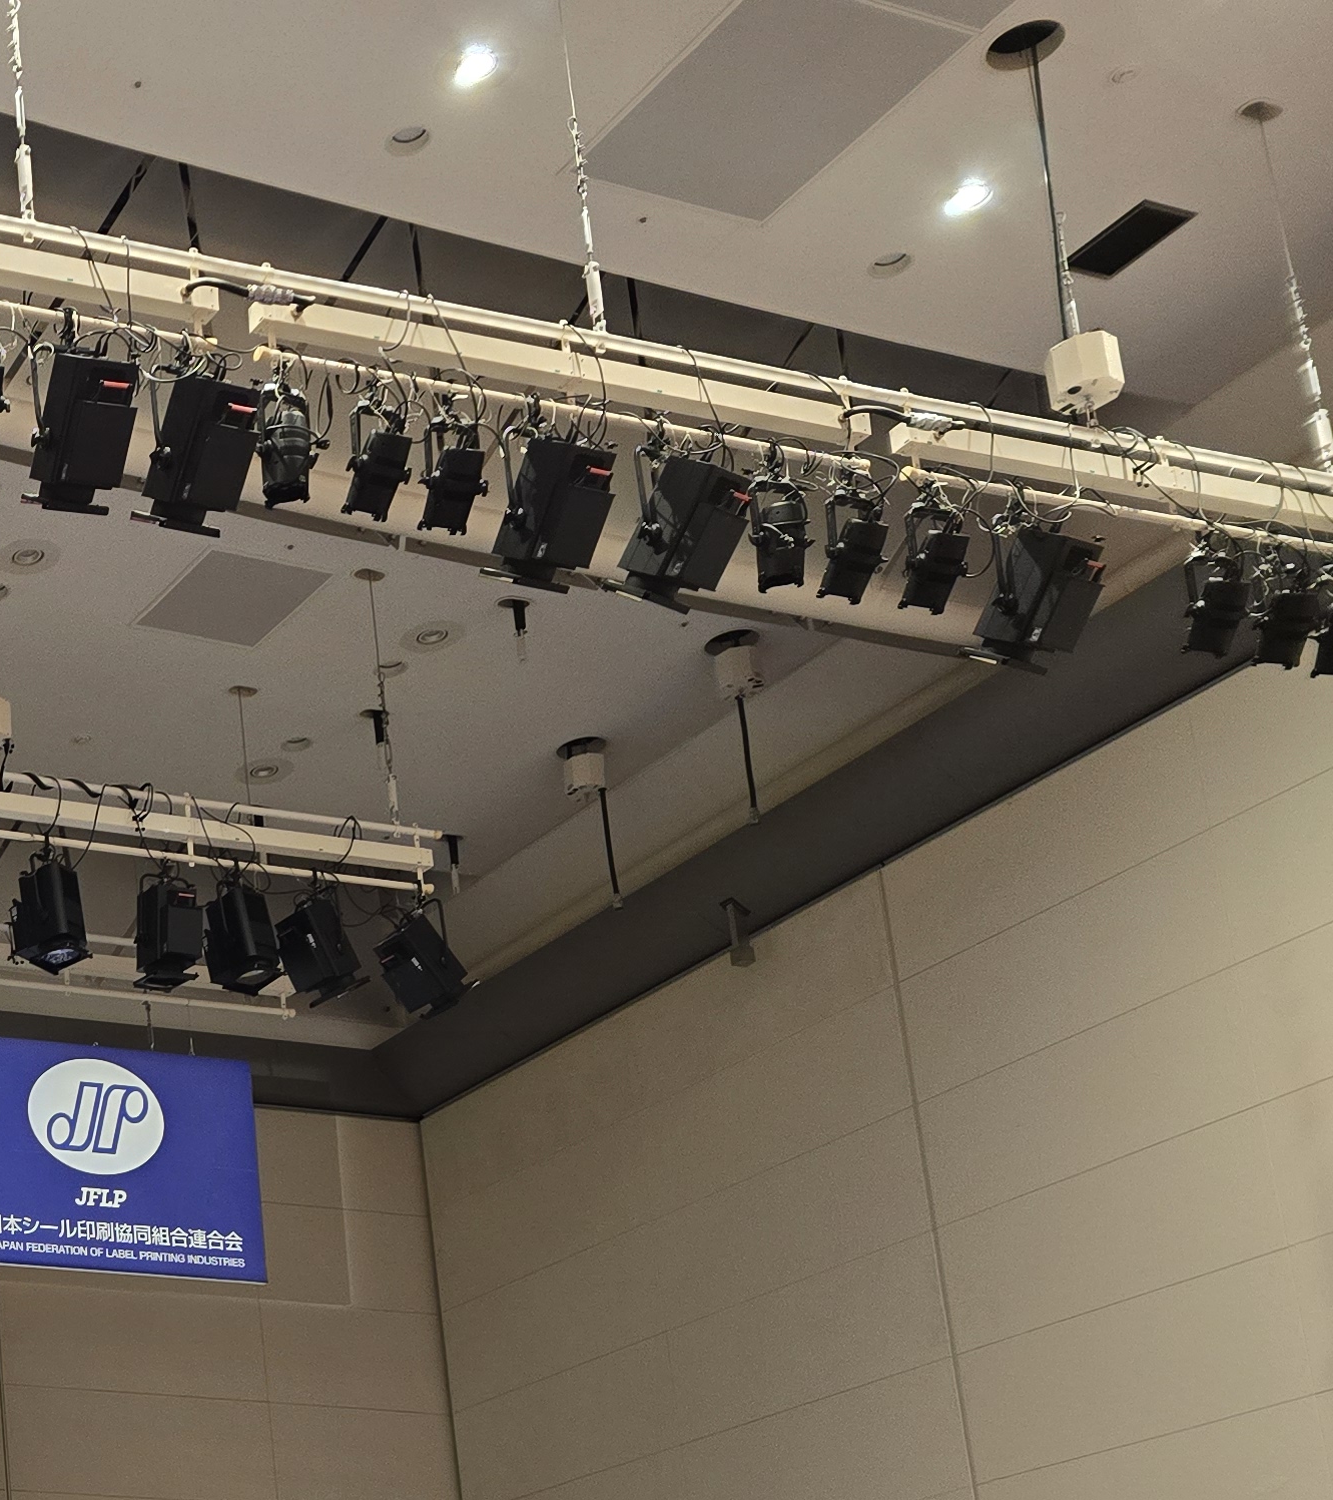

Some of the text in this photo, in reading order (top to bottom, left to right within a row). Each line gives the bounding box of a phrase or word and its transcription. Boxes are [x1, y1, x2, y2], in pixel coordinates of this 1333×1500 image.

[74, 1187, 127, 1209] JFLP
[26, 1243, 88, 1257] FEDERATION
[90, 1246, 104, 1258] OF
[106, 1248, 137, 1261] LABEL
[139, 1250, 185, 1264] PRINTING
[187, 1253, 245, 1268] INDUSTRIES
